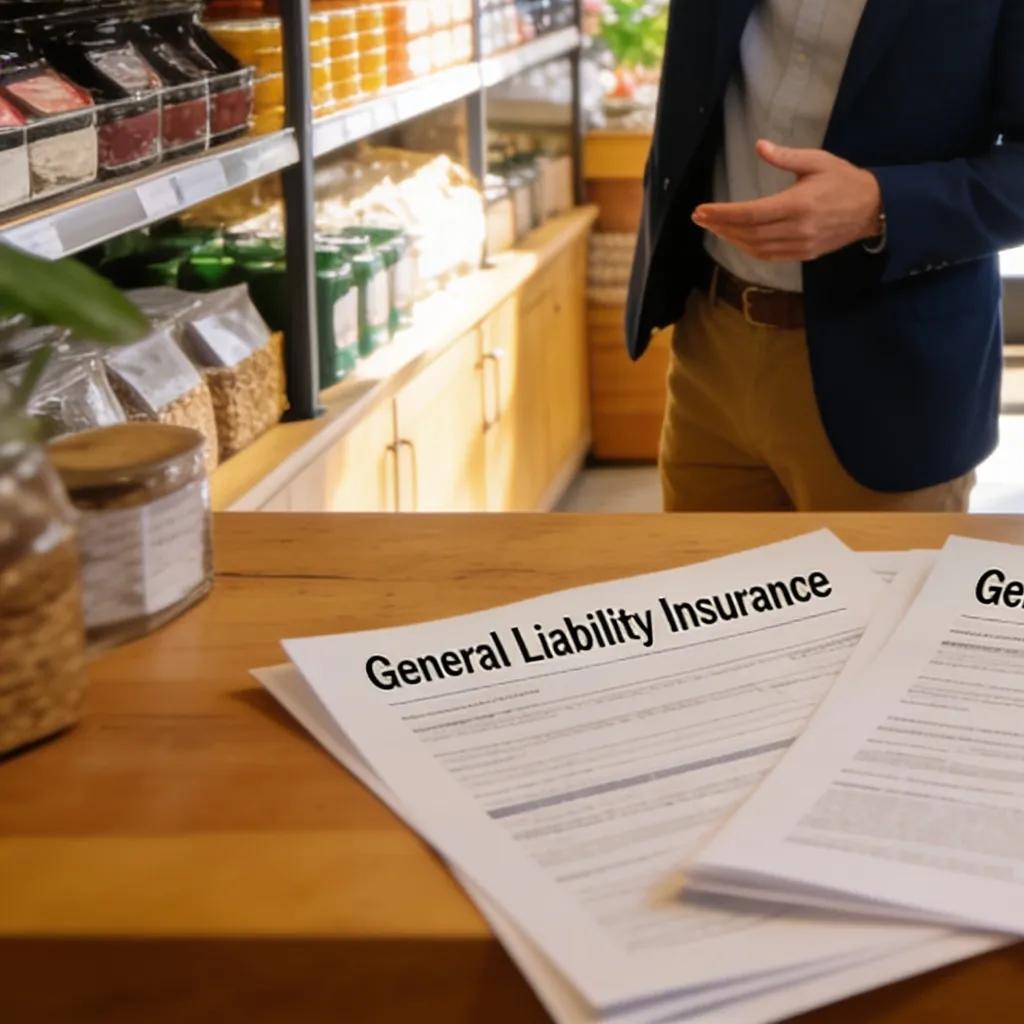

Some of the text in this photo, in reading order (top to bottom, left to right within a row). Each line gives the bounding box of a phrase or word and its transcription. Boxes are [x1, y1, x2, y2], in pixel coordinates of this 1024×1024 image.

[365, 571, 832, 691] General Liability Insurance
